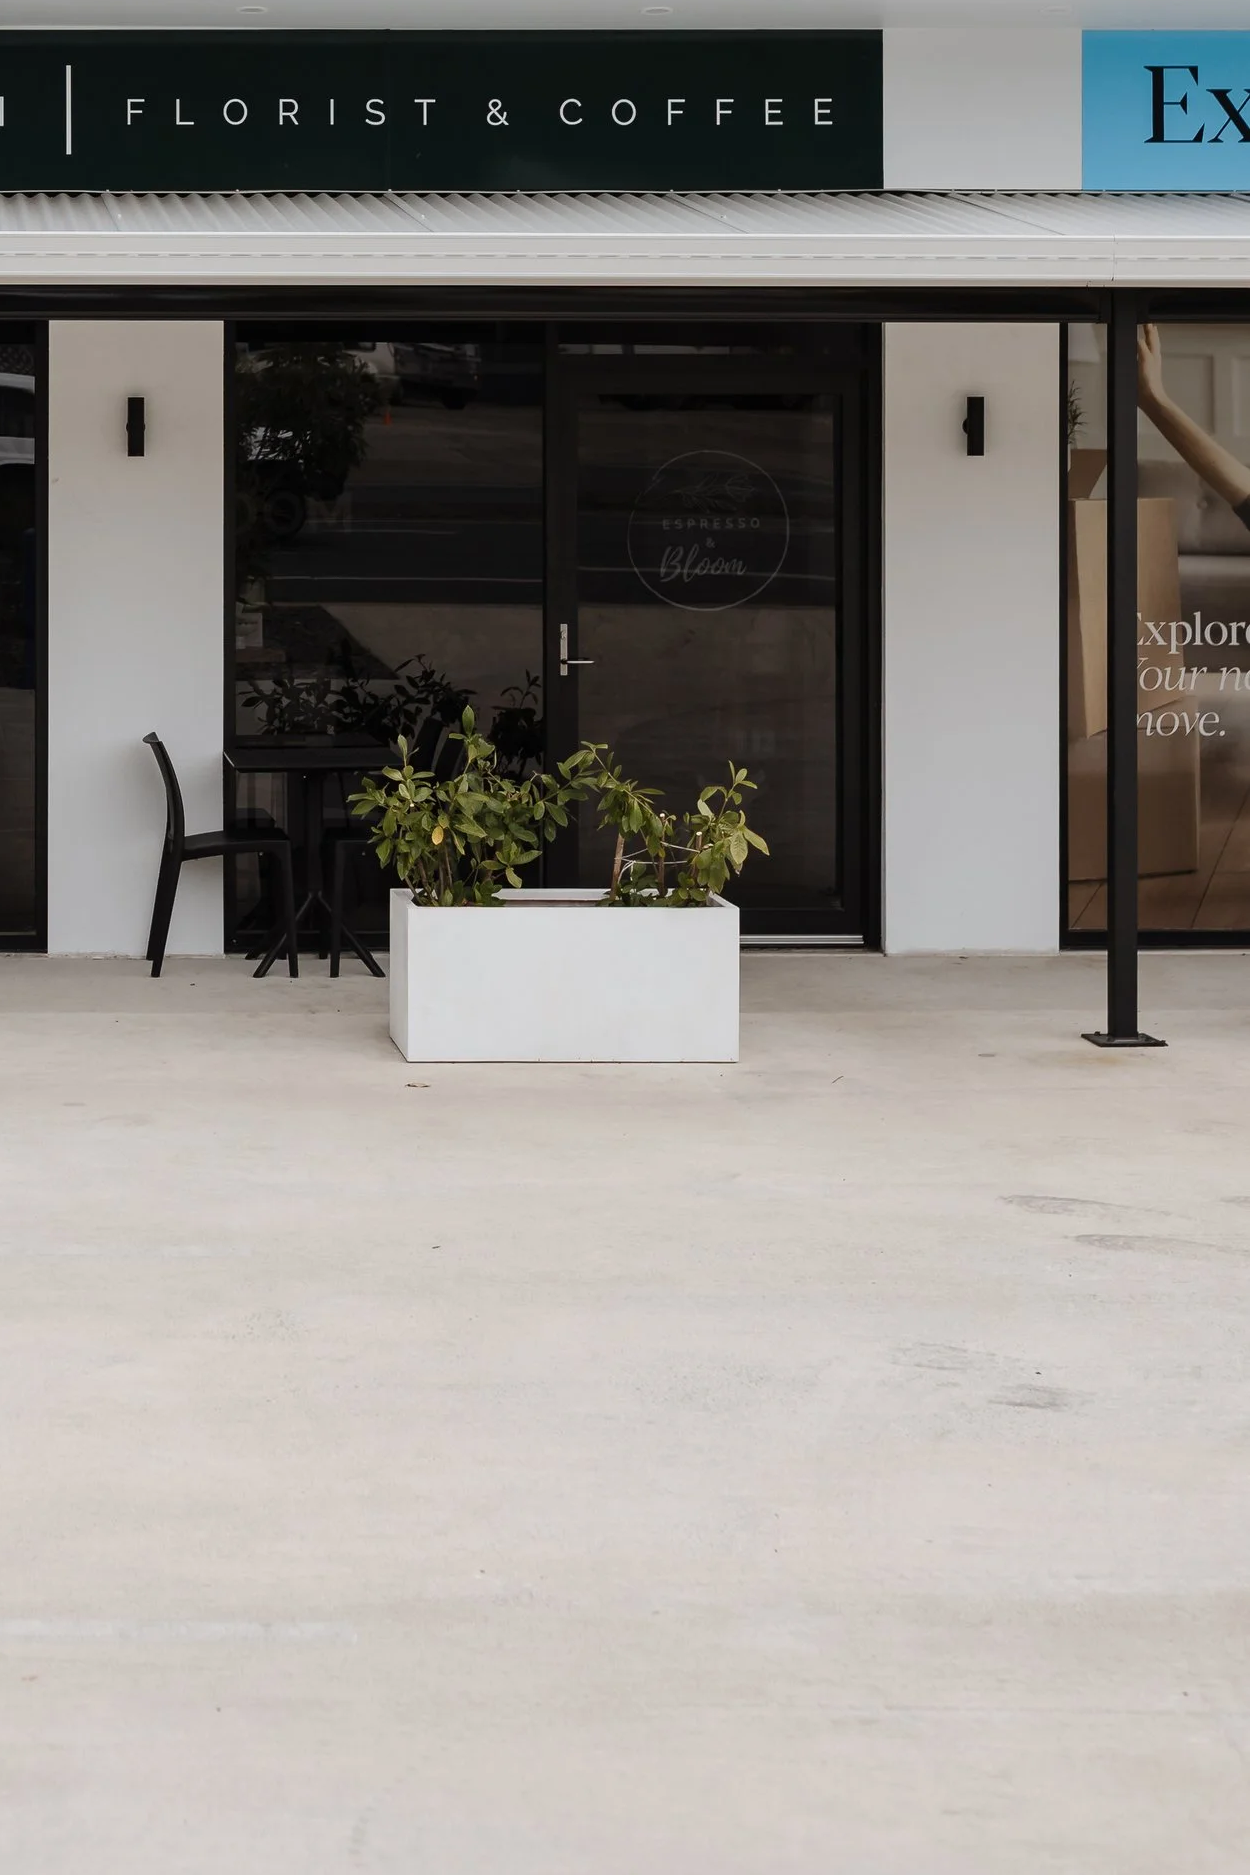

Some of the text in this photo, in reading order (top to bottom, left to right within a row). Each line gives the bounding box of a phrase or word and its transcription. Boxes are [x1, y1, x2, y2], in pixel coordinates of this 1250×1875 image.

[126, 97, 833, 126] FLORIST & COFFEE
[661, 518, 761, 530] ESPRESSO
[705, 536, 715, 548] &
[660, 544, 746, 582] Bloom
